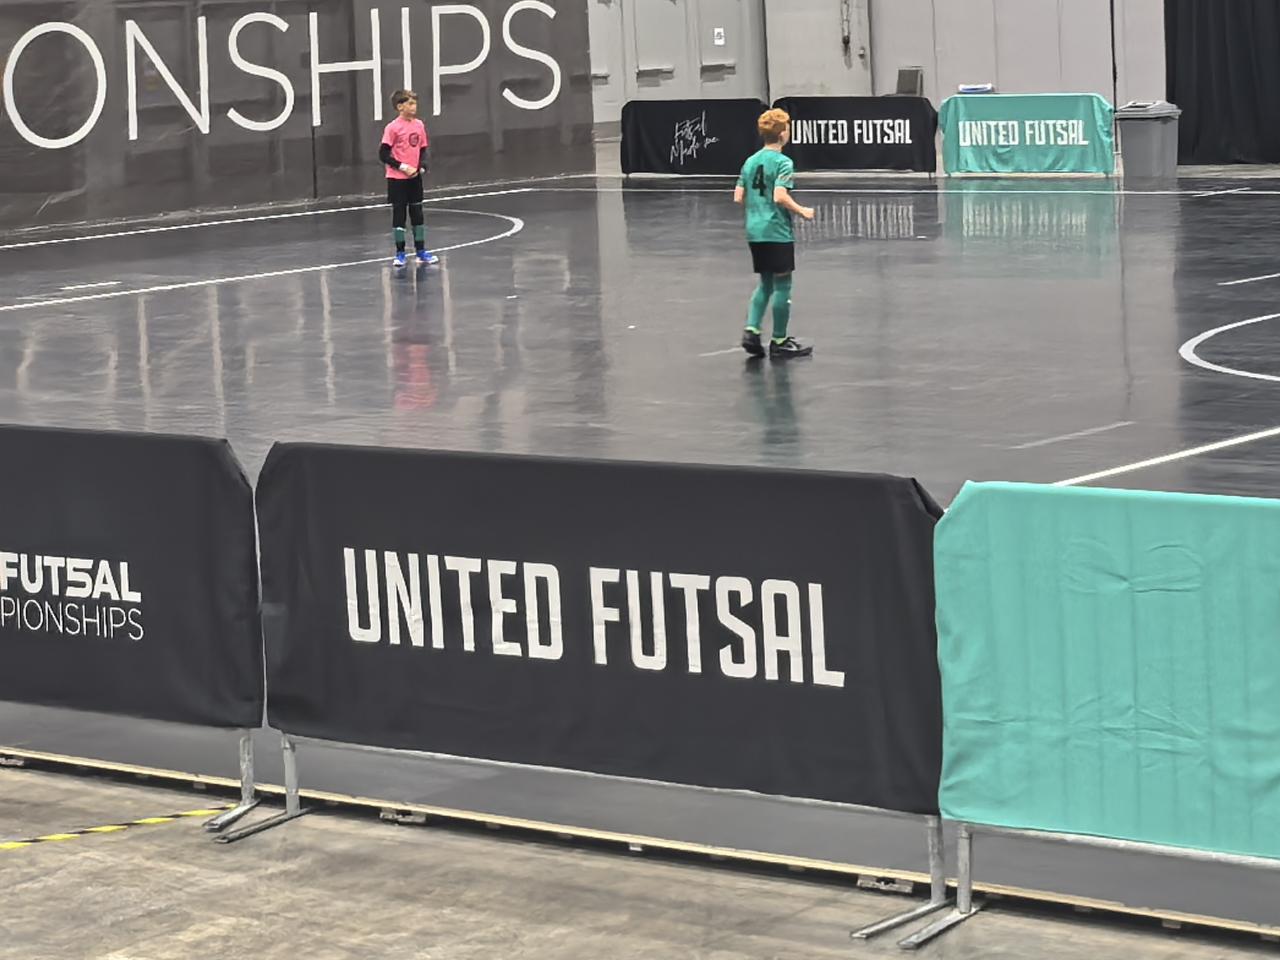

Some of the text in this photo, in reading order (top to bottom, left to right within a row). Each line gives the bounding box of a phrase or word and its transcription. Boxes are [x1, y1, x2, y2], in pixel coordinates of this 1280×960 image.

[3, 0, 561, 149] ONSHIPS
[791, 118, 912, 145] UNITED FUTSAL
[958, 119, 1089, 147] UNITED FUTSAL
[751, 164, 767, 197] 4
[0, 551, 141, 602] FUTSAL
[1, 596, 144, 640] PIONSHIPS
[344, 547, 845, 688] UNITED FUTSAL
